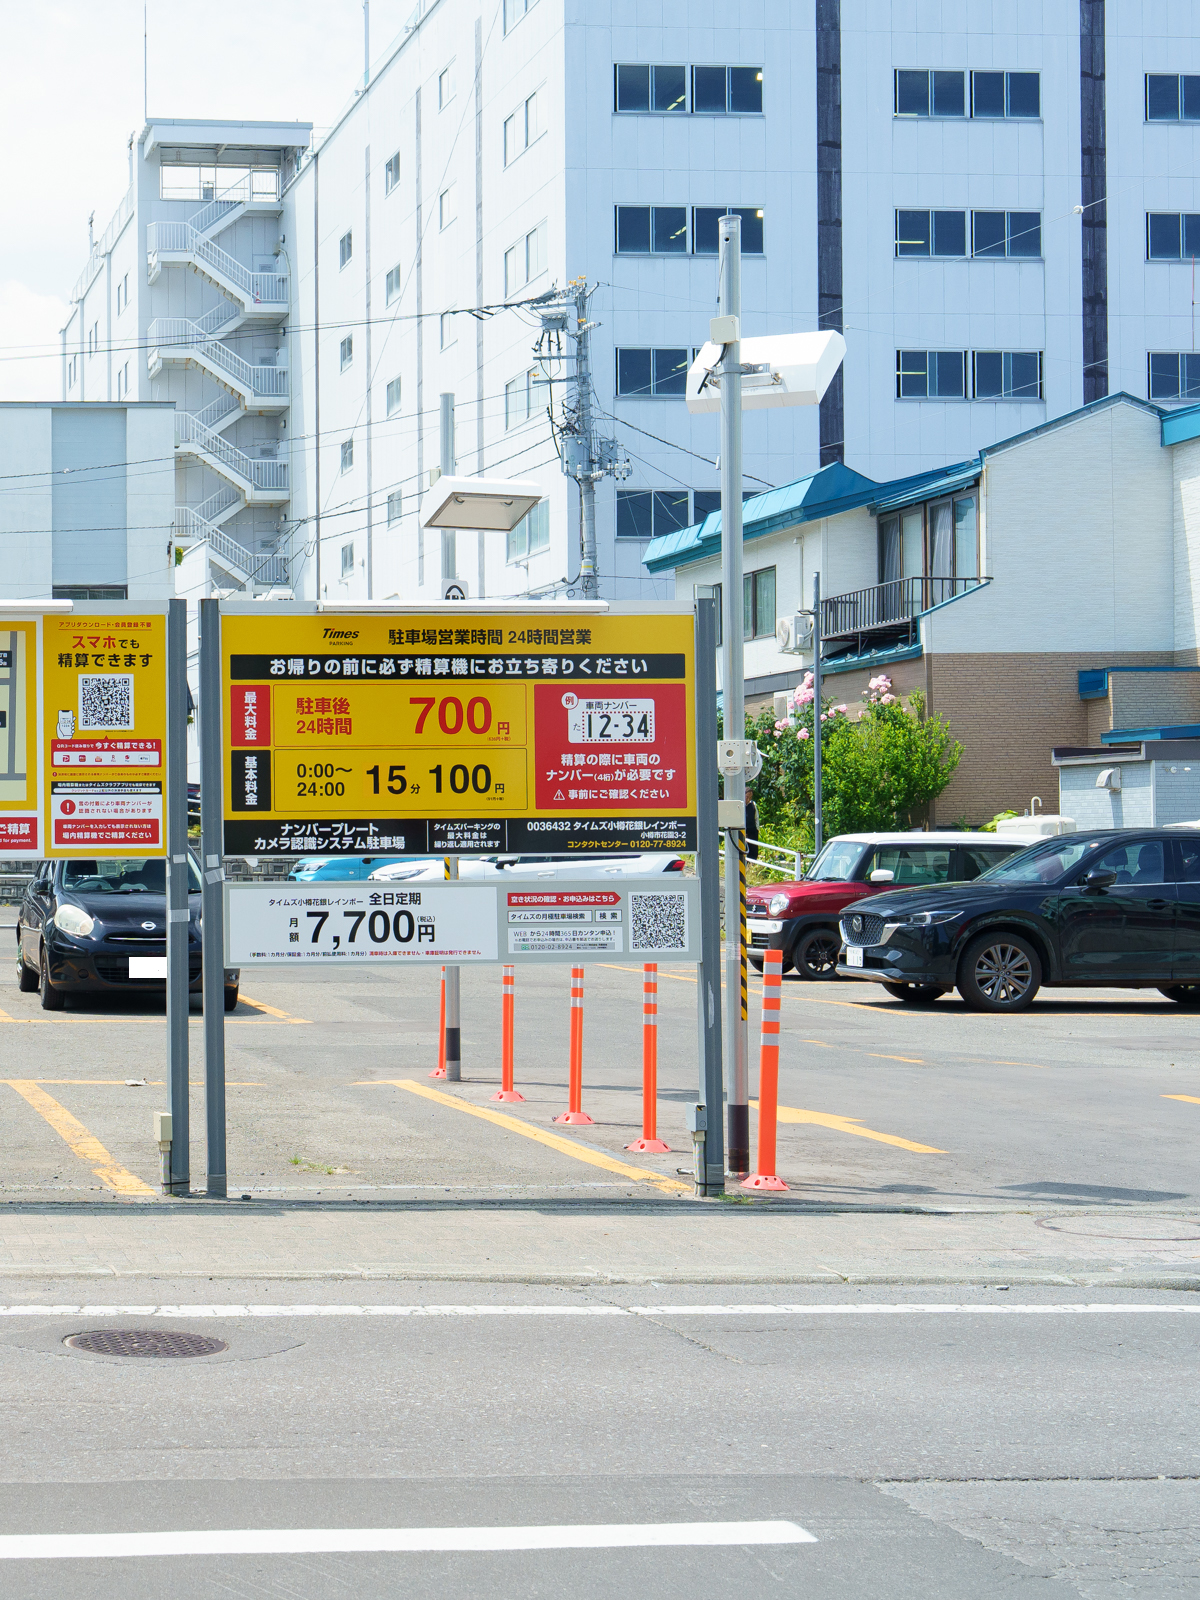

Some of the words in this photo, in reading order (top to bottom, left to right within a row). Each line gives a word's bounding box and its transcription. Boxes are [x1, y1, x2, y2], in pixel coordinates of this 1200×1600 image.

[322, 628, 360, 639] Times
[388, 629, 503, 646] 駐車場営業時間
[508, 629, 592, 646] 24時間営業
[72, 635, 140, 649] スマホでも
[58, 653, 153, 668] 精算できます
[270, 658, 647, 676] お帰りの前に必ず精算機にお立ち寄りください
[296, 697, 350, 715] 駐車後
[565, 695, 575, 706] 例
[585, 701, 637, 711] 車両ナンバー
[244, 691, 257, 741] 最大料金
[296, 717, 352, 736] 24時間
[573, 723, 581, 731] た
[588, 713, 649, 738] 12-34
[560, 753, 661, 766] 精算の際に車両の
[244, 756, 258, 806] 基本料金
[546, 769, 676, 782] ナンバー(4桁)が必要です
[297, 782, 345, 797] 24:00
[568, 789, 670, 800] 事前にご確認ください
[281, 823, 379, 837] ナンバープレート
[433, 823, 501, 831] タイムズパーキングの
[527, 822, 571, 831] 0036432
[573, 821, 686, 831] タイムズ小樽花銀レインボー
[62, 831, 152, 839] 場内精算機でご精算ください
[447, 832, 487, 840] 最大料金は
[640, 831, 687, 840] 小樽市花園3-2
[254, 836, 406, 851] カメラ認識システム駐車場
[434, 840, 501, 848] 繰り返し適用されます
[630, 840, 687, 848] 0120-77-8924
[268, 898, 364, 906] タイムズ小樽花銀レインボー
[369, 892, 421, 906] 全日定期
[511, 895, 615, 904] 空き状況の確認・お申込みはこちら
[416, 915, 436, 923] (税込)
[600, 912, 618, 920] 検索
[289, 917, 300, 943] 月額
